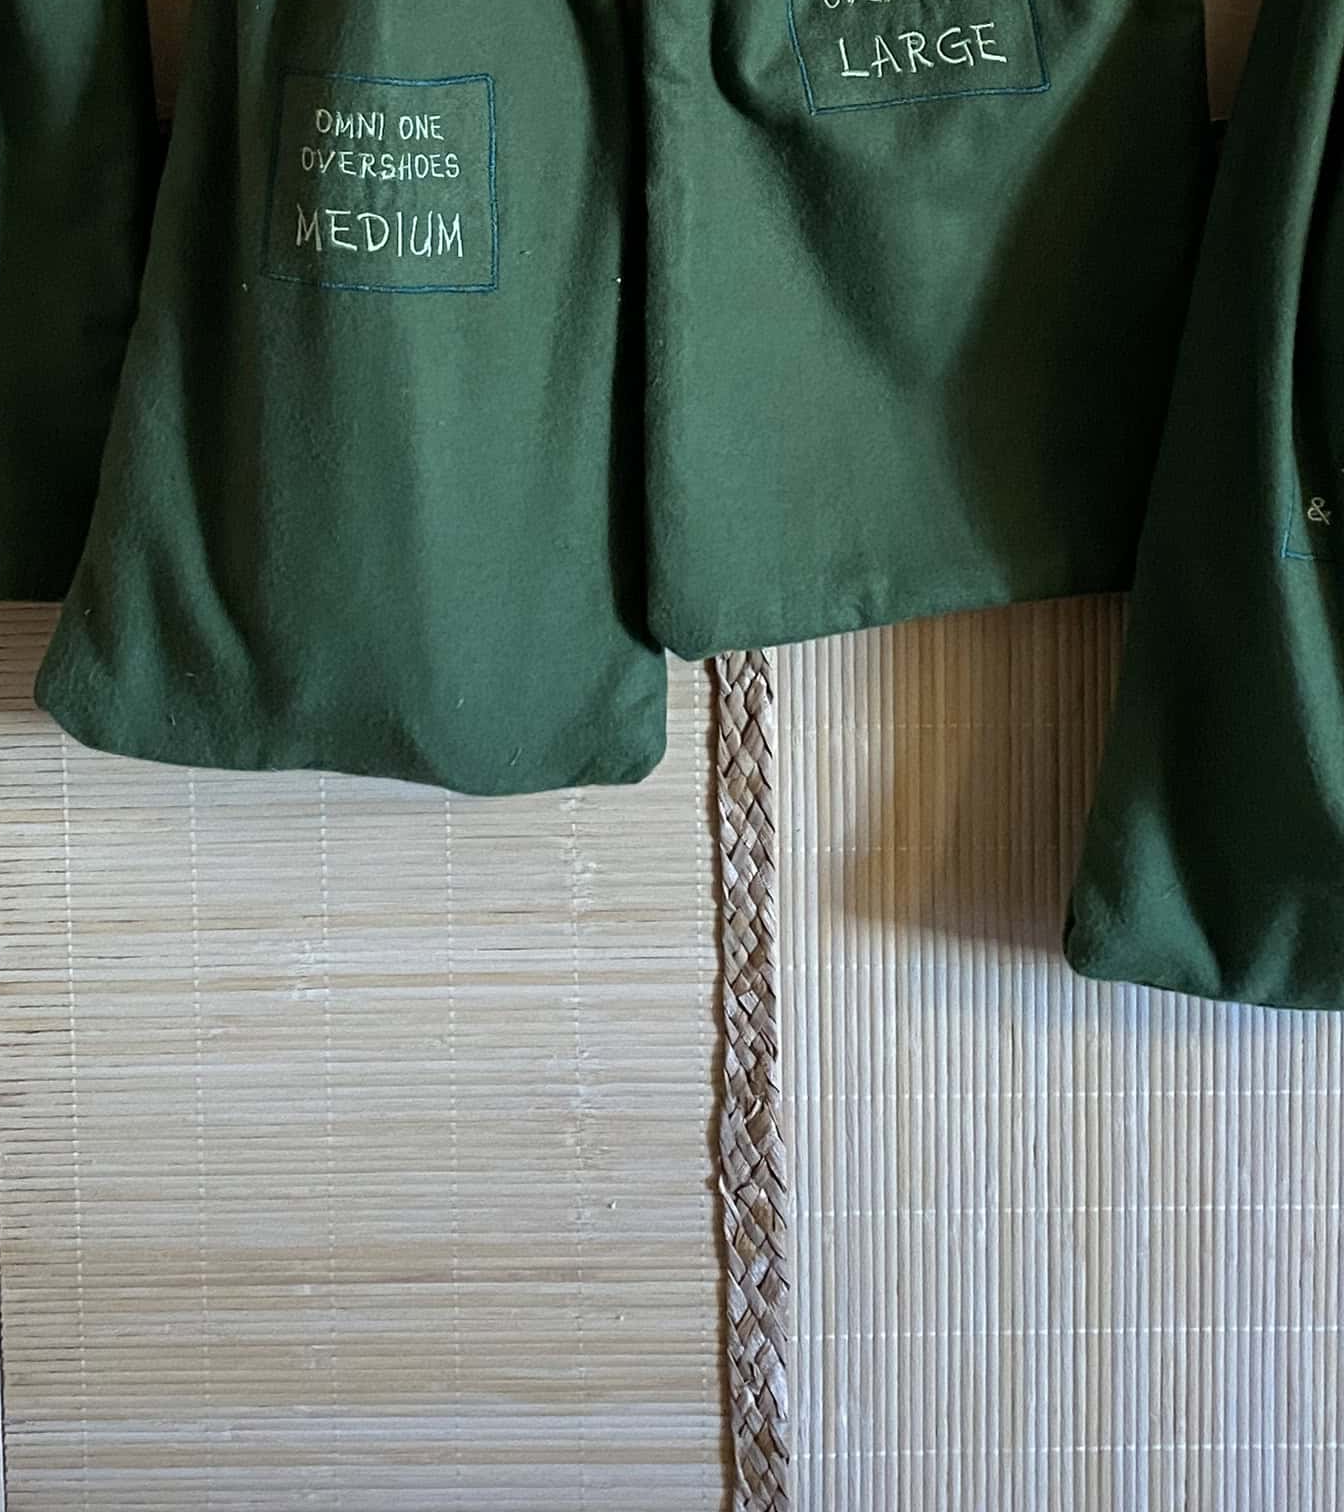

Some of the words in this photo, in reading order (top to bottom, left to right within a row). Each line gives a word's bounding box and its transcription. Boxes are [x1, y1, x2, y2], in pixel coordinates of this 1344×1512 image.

[839, 22, 1007, 78] LARGE
[315, 108, 384, 140] OMNI
[399, 115, 444, 141] ONE
[301, 146, 460, 180] OVERSHOES
[296, 203, 463, 257] MEDIUM
[1307, 496, 1331, 526] &
